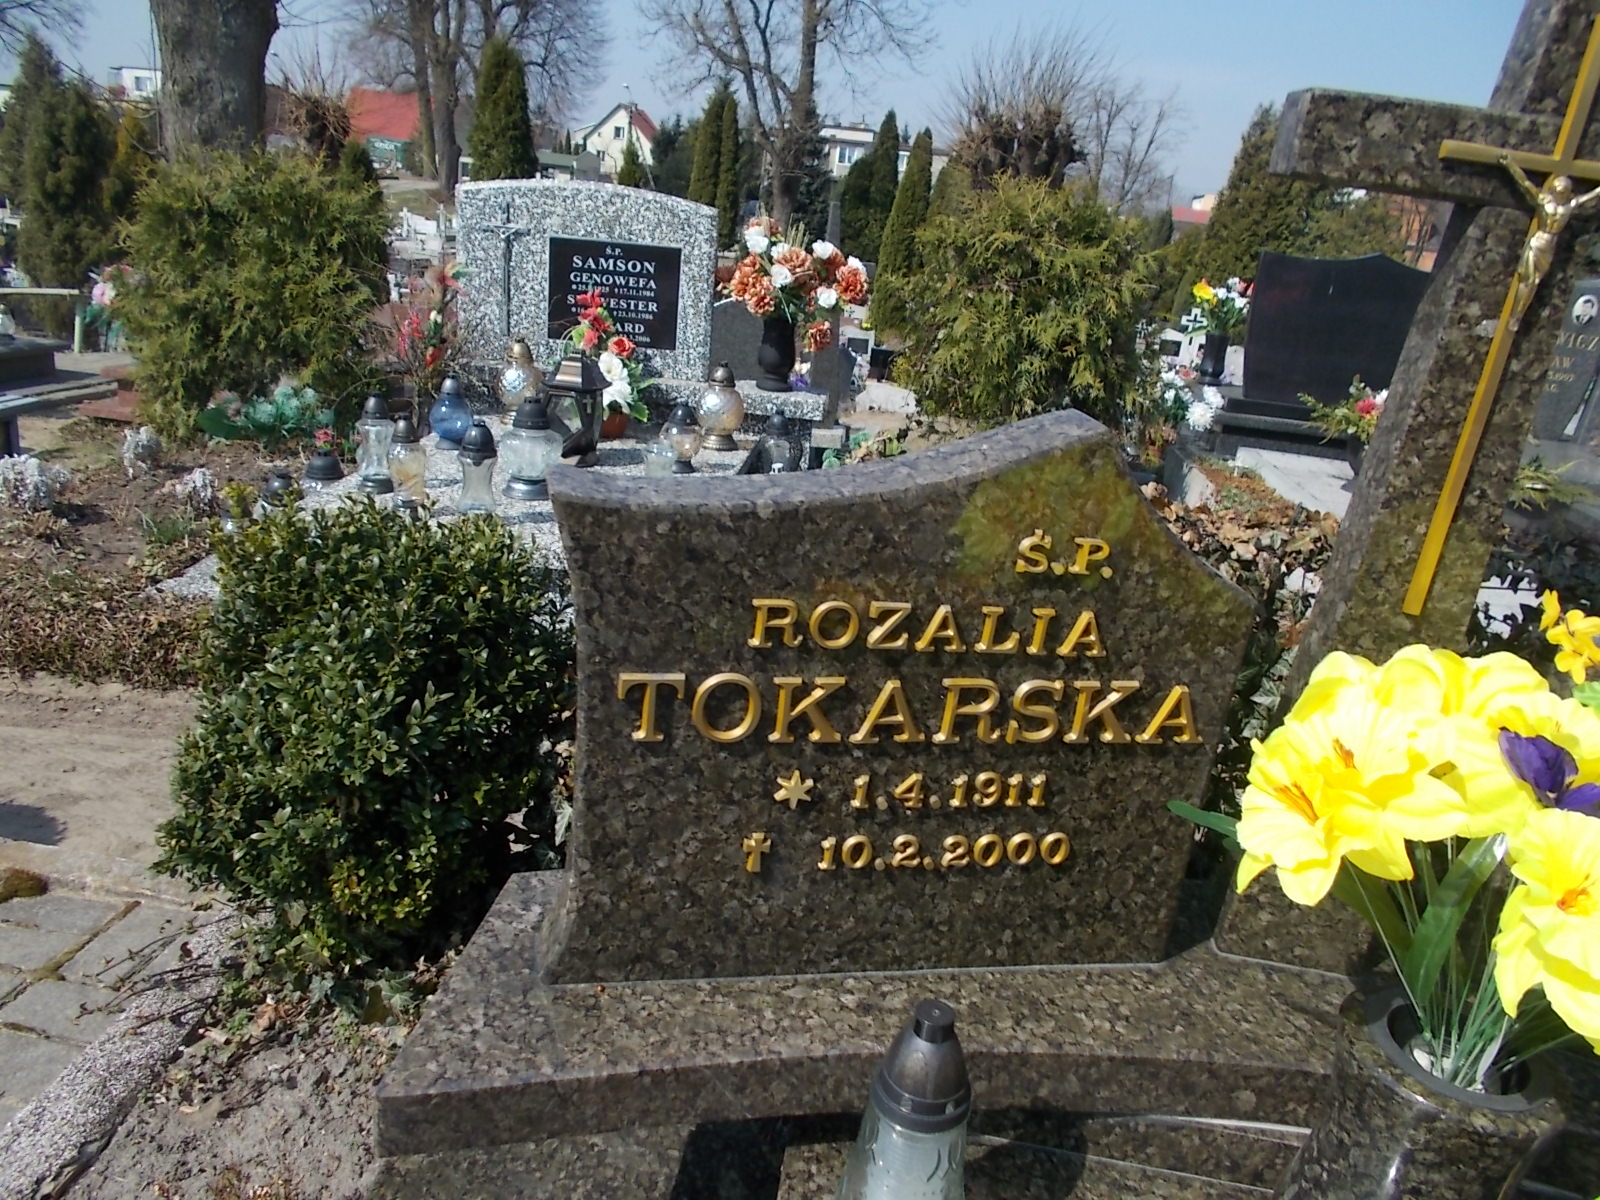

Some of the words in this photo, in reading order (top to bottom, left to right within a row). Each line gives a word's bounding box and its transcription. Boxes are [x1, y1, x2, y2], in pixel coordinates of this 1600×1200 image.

[572, 255, 656, 274] SAMSON
[570, 271, 656, 289] GENOWEFA
[567, 294, 658, 312] SESTER
[615, 321, 645, 334] ARD
[747, 598, 1107, 658] ROZALIA
[617, 673, 1202, 745] TOKARSKA
[853, 771, 1046, 810] 1.4.1911
[818, 831, 1071, 872] 10.2.2000
